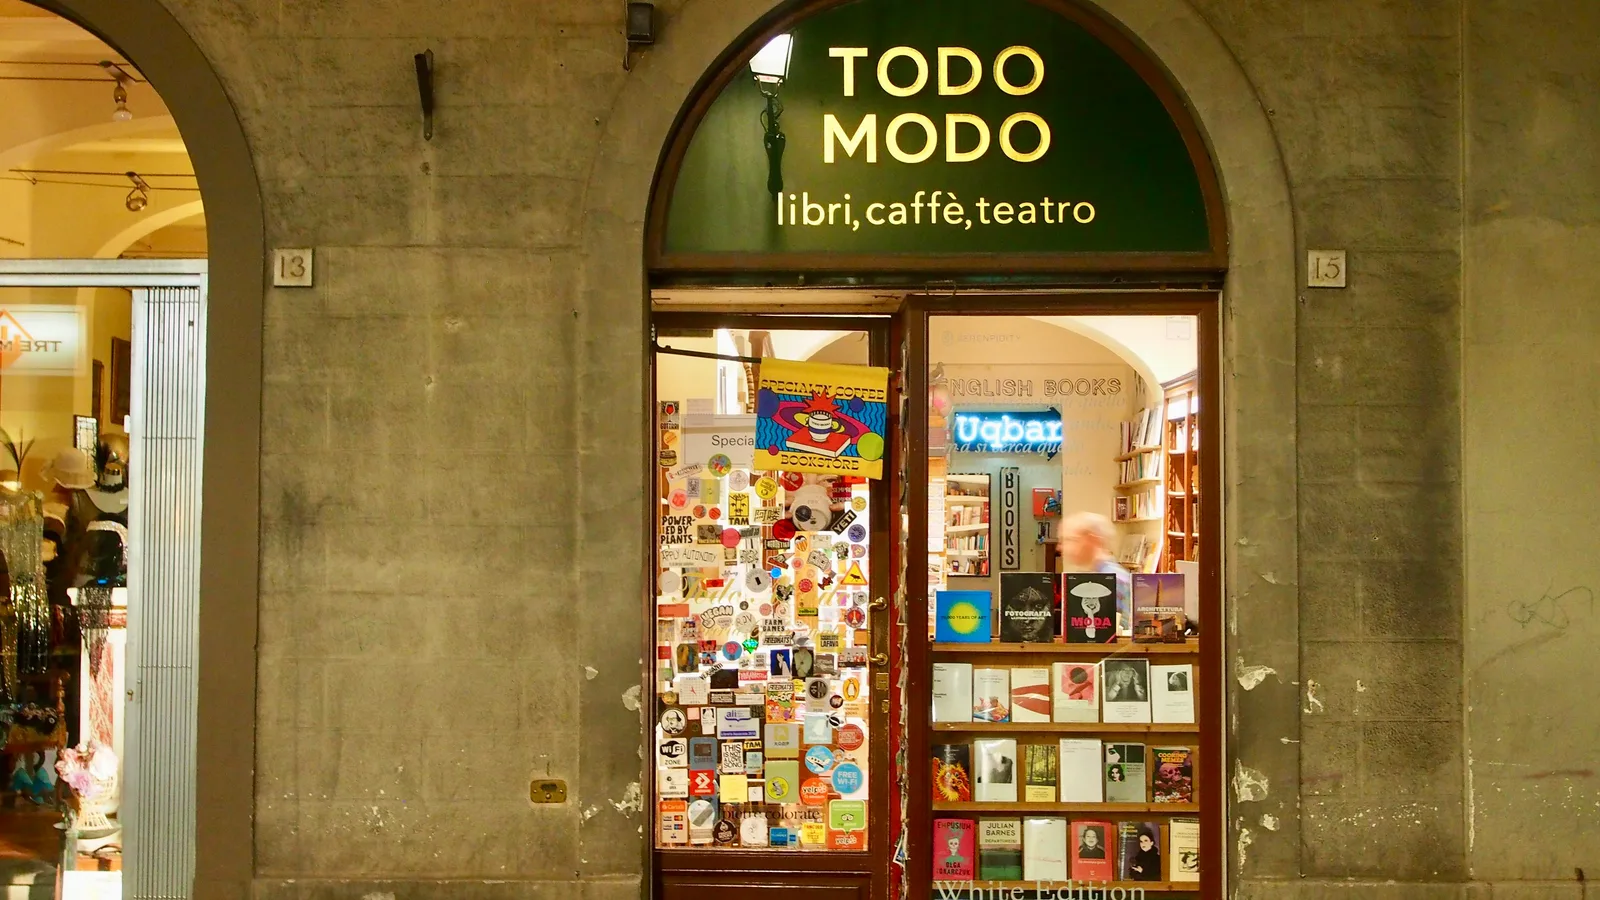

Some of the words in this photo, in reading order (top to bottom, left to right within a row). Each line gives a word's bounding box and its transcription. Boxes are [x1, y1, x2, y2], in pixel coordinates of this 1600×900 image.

[829, 45, 1044, 97] TODO
[823, 112, 1051, 164] MODO
[280, 255, 306, 279] 13
[1315, 257, 1340, 279] 15
[760, 379, 832, 396] SPECIALTY
[835, 386, 885, 400] COFFEE
[1043, 378, 1122, 397] BOOKS
[955, 414, 1063, 449] Uqbar
[781, 454, 859, 470] BOOKSTORE
[833, 512, 856, 532] YETI
[1005, 472, 1014, 566] BOOKS
[661, 535, 693, 544] PLANTS
[677, 526, 688, 534] BY
[1071, 617, 1112, 627] MODA
[726, 710, 737, 718] ali
[765, 806, 820, 820] colorate
[933, 880, 1025, 900] White
[1036, 879, 1146, 900] Edition
